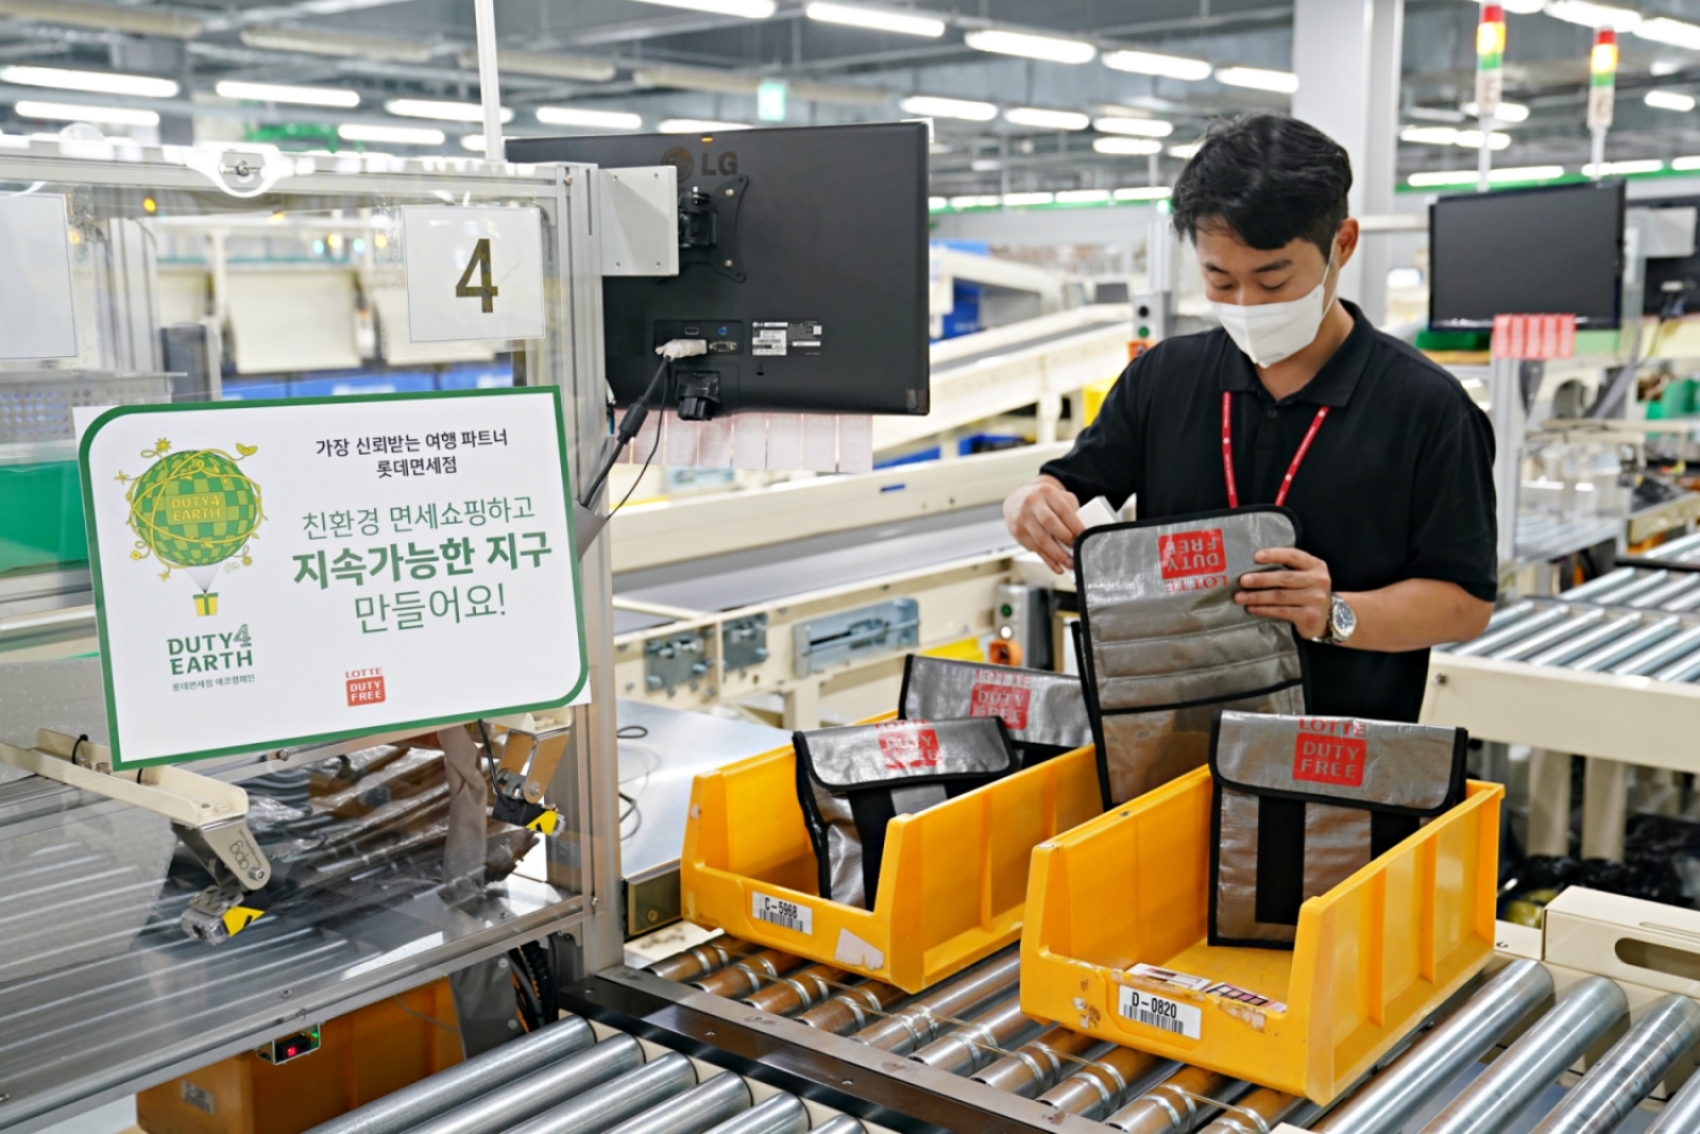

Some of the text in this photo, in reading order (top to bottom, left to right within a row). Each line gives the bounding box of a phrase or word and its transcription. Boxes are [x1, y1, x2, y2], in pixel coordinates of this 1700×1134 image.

[701, 151, 739, 177] LG
[455, 238, 499, 314] 4
[315, 428, 508, 457] 가장 신뢰받는 여행 파트너
[376, 455, 458, 479] 롯데면세점
[171, 494, 220, 509] DUTY4
[172, 507, 221, 522] EARTH
[302, 496, 536, 540] 친환경 면세쇼핑하고
[292, 531, 552, 590] 지속가능한 지구
[1168, 552, 1219, 572] DUTY
[354, 582, 506, 635] 만들어요!
[166, 623, 252, 656] DUTY4
[169, 649, 253, 676] EARTH
[345, 666, 382, 679] LOTTE
[350, 680, 382, 692] DUTY
[351, 690, 382, 702] FREE
[978, 690, 1024, 707] DUTY
[1298, 718, 1367, 737] LOTTE
[1303, 741, 1360, 760] DUTY
[1301, 758, 1357, 779] FREE
[1132, 991, 1177, 1019] D-0820
